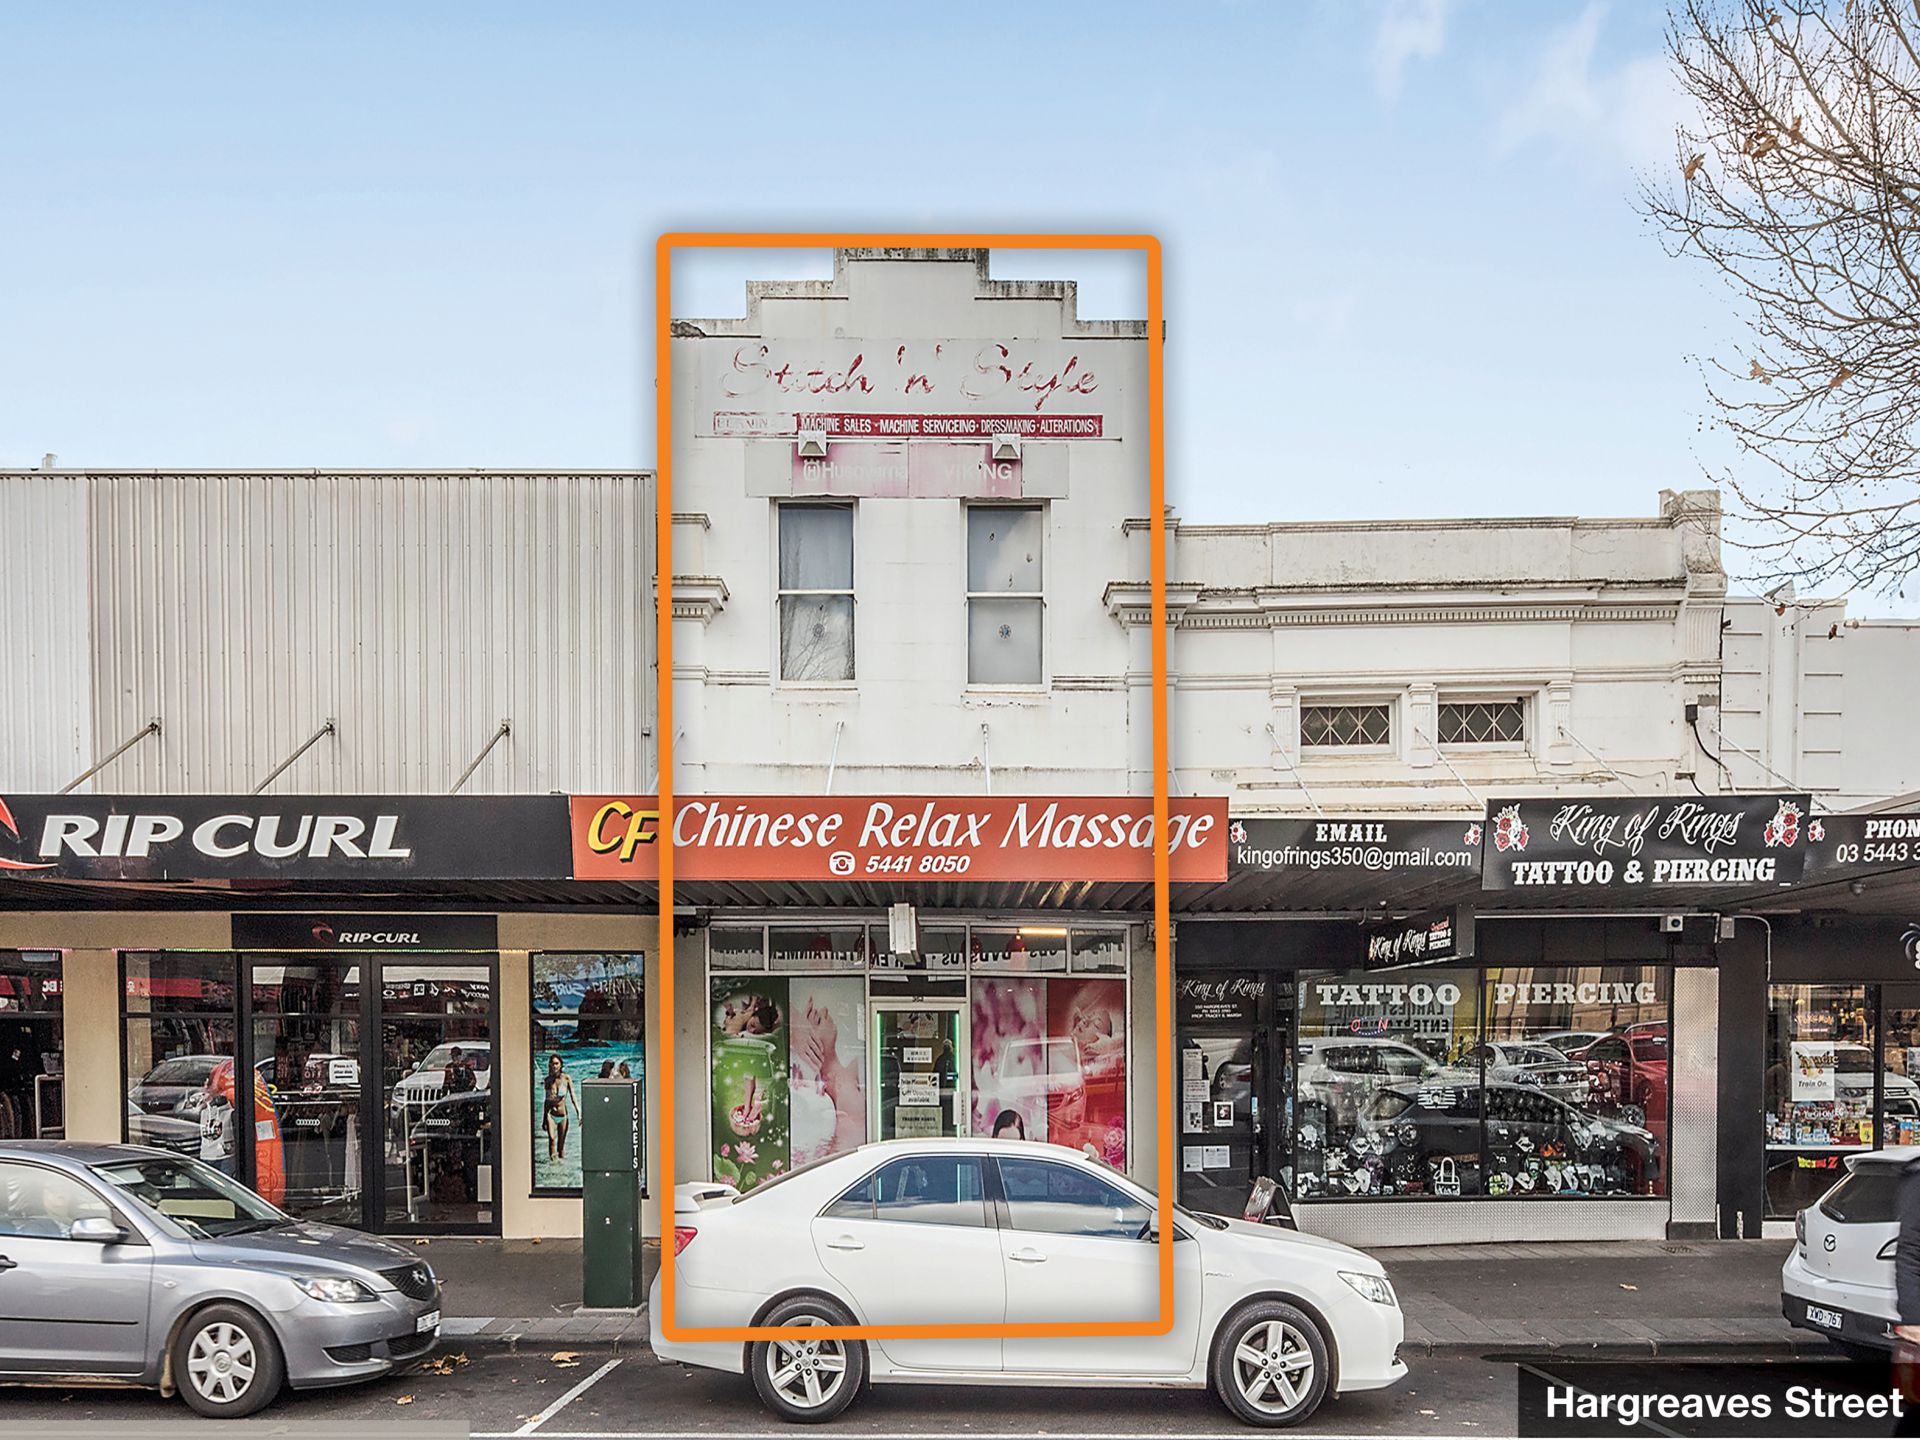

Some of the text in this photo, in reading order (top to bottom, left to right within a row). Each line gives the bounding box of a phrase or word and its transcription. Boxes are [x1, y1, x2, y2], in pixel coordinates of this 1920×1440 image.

[801, 417, 840, 433] MACHINE
[844, 418, 872, 433] SALES
[880, 418, 919, 434] MACHINE
[981, 418, 1035, 434] DRESSMAKING
[1040, 418, 1095, 434] ALTERATIONS
[38, 814, 412, 858] RIP CURL
[587, 800, 660, 863] CF
[672, 801, 843, 848] Chinese
[858, 802, 992, 848] Relax
[1315, 823, 1388, 843] EMAIL
[1550, 802, 1746, 857] King of Rings
[1864, 819, 1920, 839] PHON
[864, 855, 971, 873] 5441 8050
[1237, 846, 1472, 871] kingofrings350@gmail.com
[1836, 844, 1859, 863] 03
[1863, 843, 1908, 862] 5443
[1511, 857, 1776, 886] TATTOO & PIERCING
[1402, 929, 1428, 957] Rings
[1183, 978, 1266, 1001] King of Rings
[1316, 983, 1656, 1006] TATTOO PIERCING
